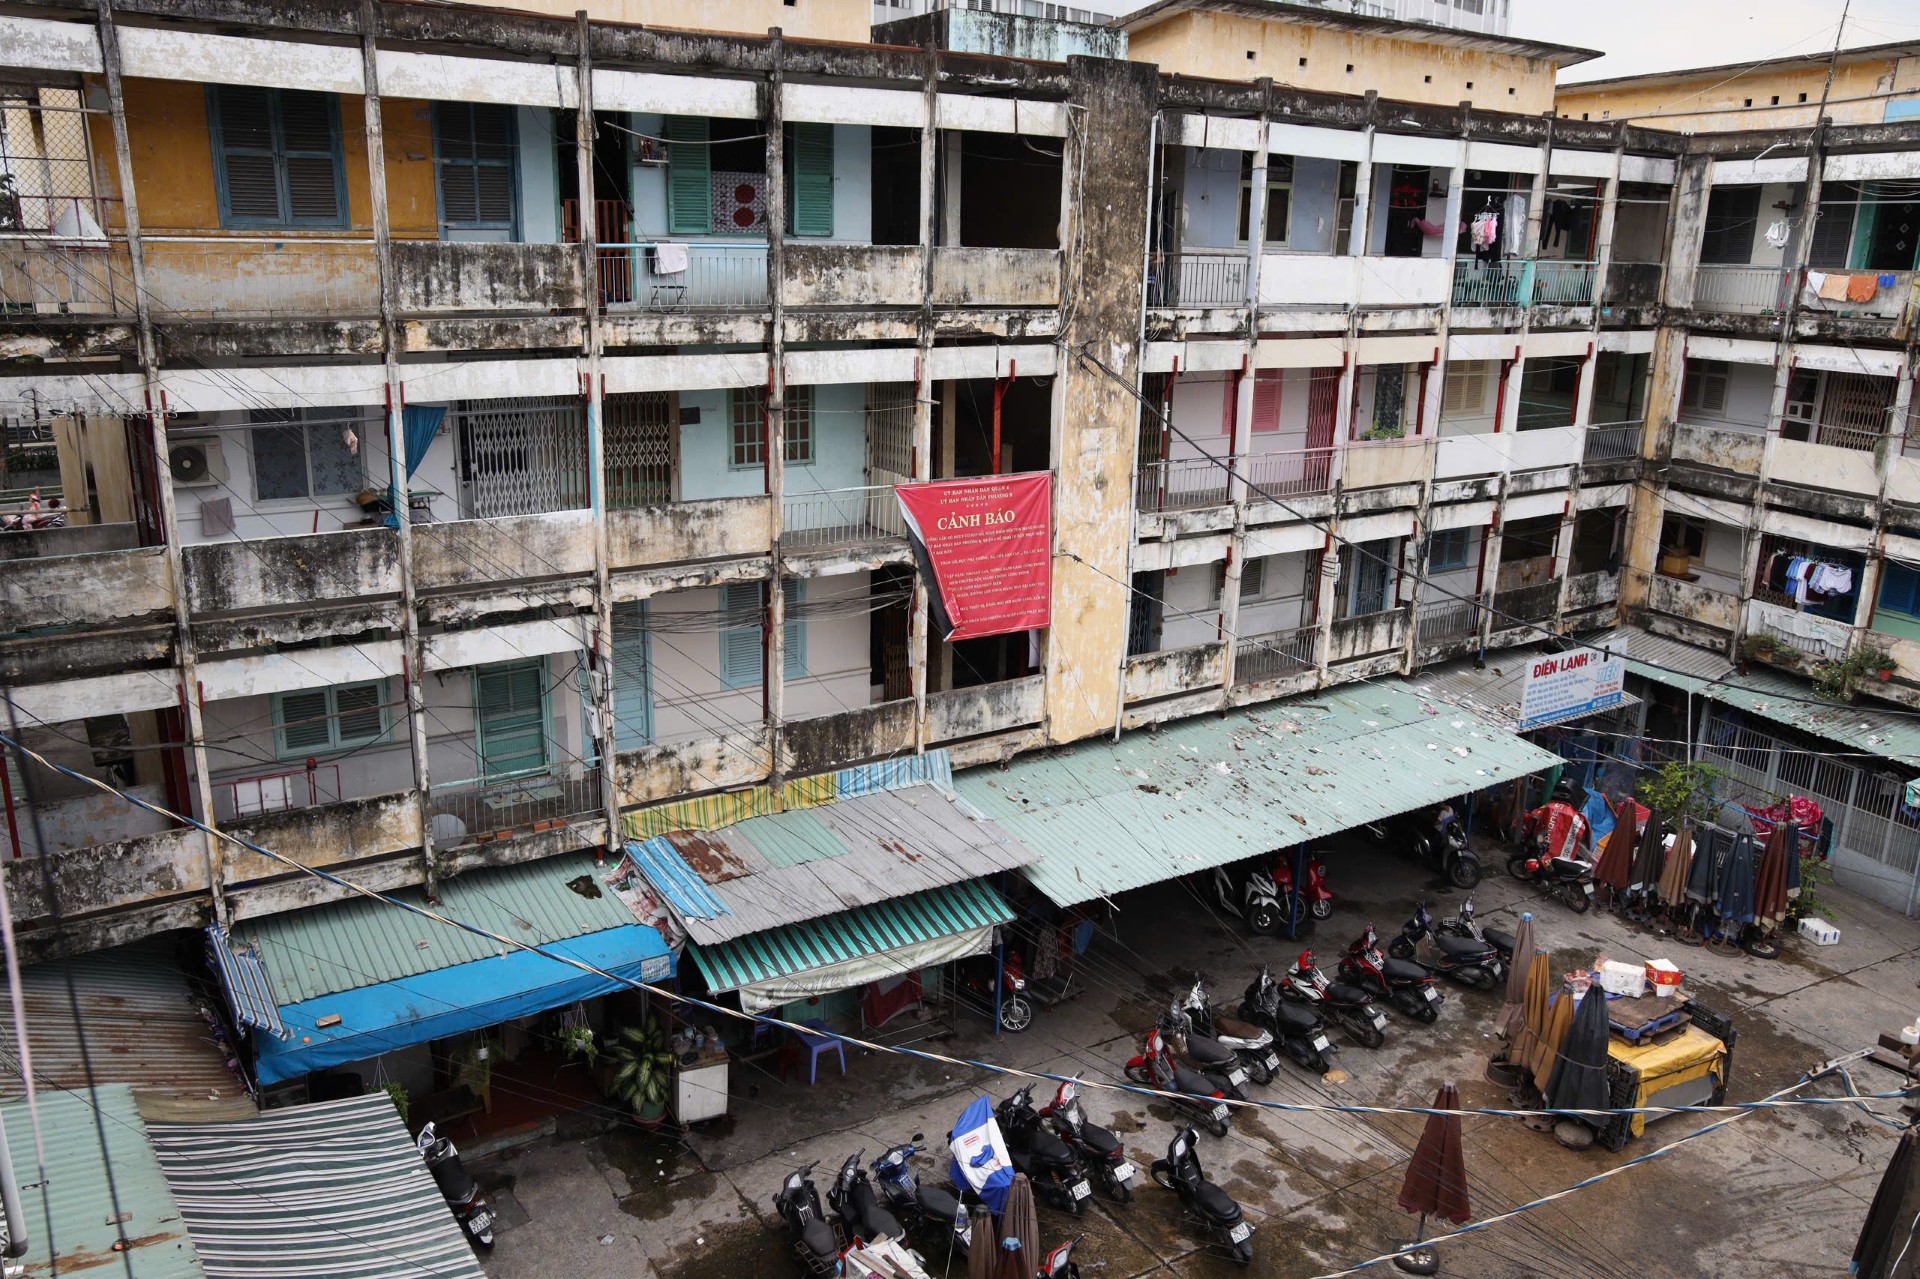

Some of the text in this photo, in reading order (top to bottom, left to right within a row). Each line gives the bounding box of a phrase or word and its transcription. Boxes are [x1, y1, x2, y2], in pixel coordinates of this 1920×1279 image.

[937, 507, 1016, 530] CẢNH BÁO
[1533, 659, 1558, 679] ĐIỆN
[1560, 653, 1589, 673] LẠNH
